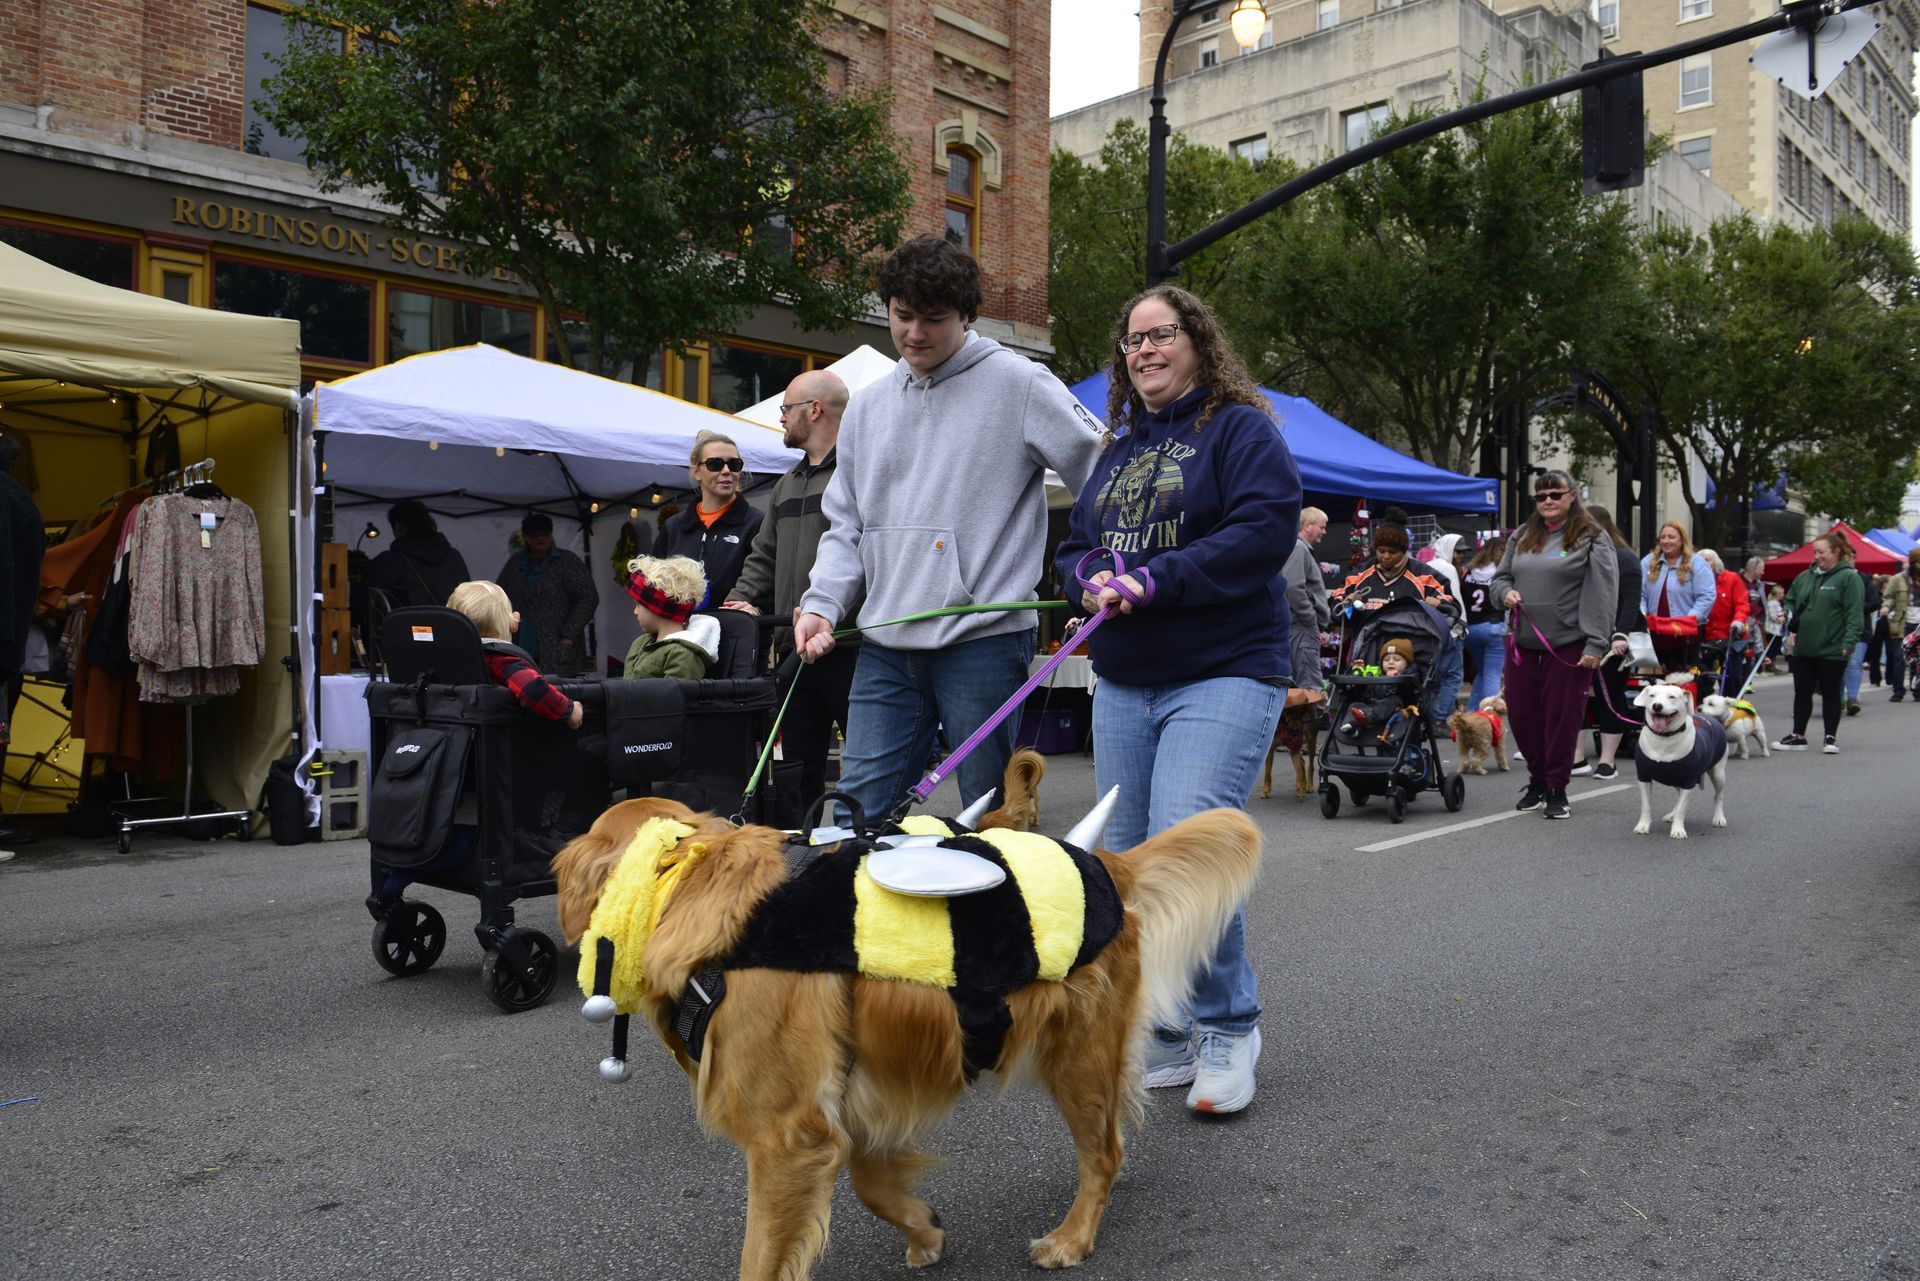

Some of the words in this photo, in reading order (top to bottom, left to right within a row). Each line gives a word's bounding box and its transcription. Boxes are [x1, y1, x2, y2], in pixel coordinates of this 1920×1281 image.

[172, 196, 535, 287] ROBINSON-SCHE
[1471, 588, 1485, 612] 2
[624, 741, 673, 754] WONDERFOLD
